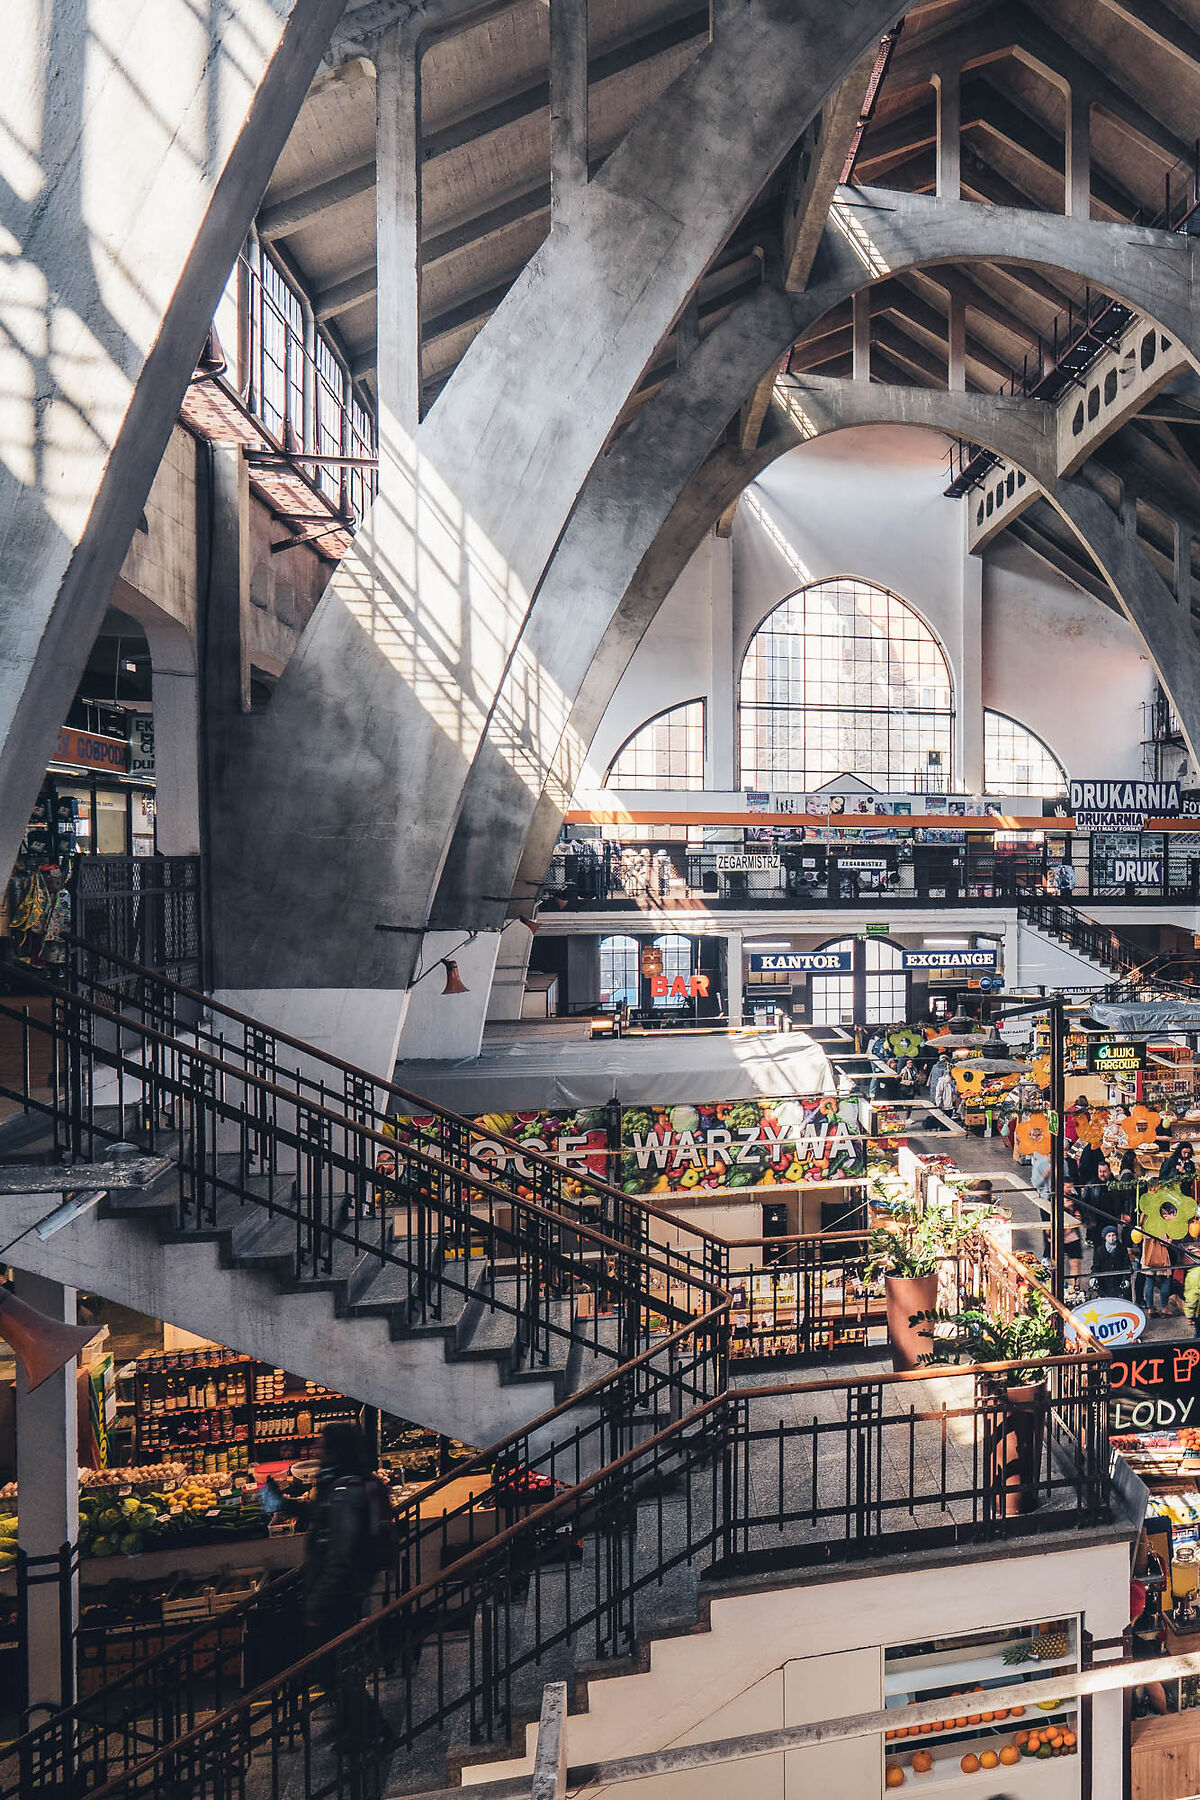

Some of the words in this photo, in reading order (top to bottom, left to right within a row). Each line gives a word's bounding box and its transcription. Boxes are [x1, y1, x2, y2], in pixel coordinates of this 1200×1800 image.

[1070, 783, 1180, 809] DRUKARNIA
[1077, 813, 1143, 825] DRUKARNIA
[718, 855, 779, 869] ZEGARMISTRZ
[1115, 861, 1159, 882] DRUK
[761, 955, 841, 969] KANTOR
[906, 953, 994, 966] EXCHANGE
[651, 975, 710, 997] BAR
[1095, 1060, 1140, 1070] TARGOWA
[634, 1123, 857, 1169] WARZYWA
[1089, 1318, 1128, 1340] LOTTO
[1115, 1397, 1195, 1429] LODY
